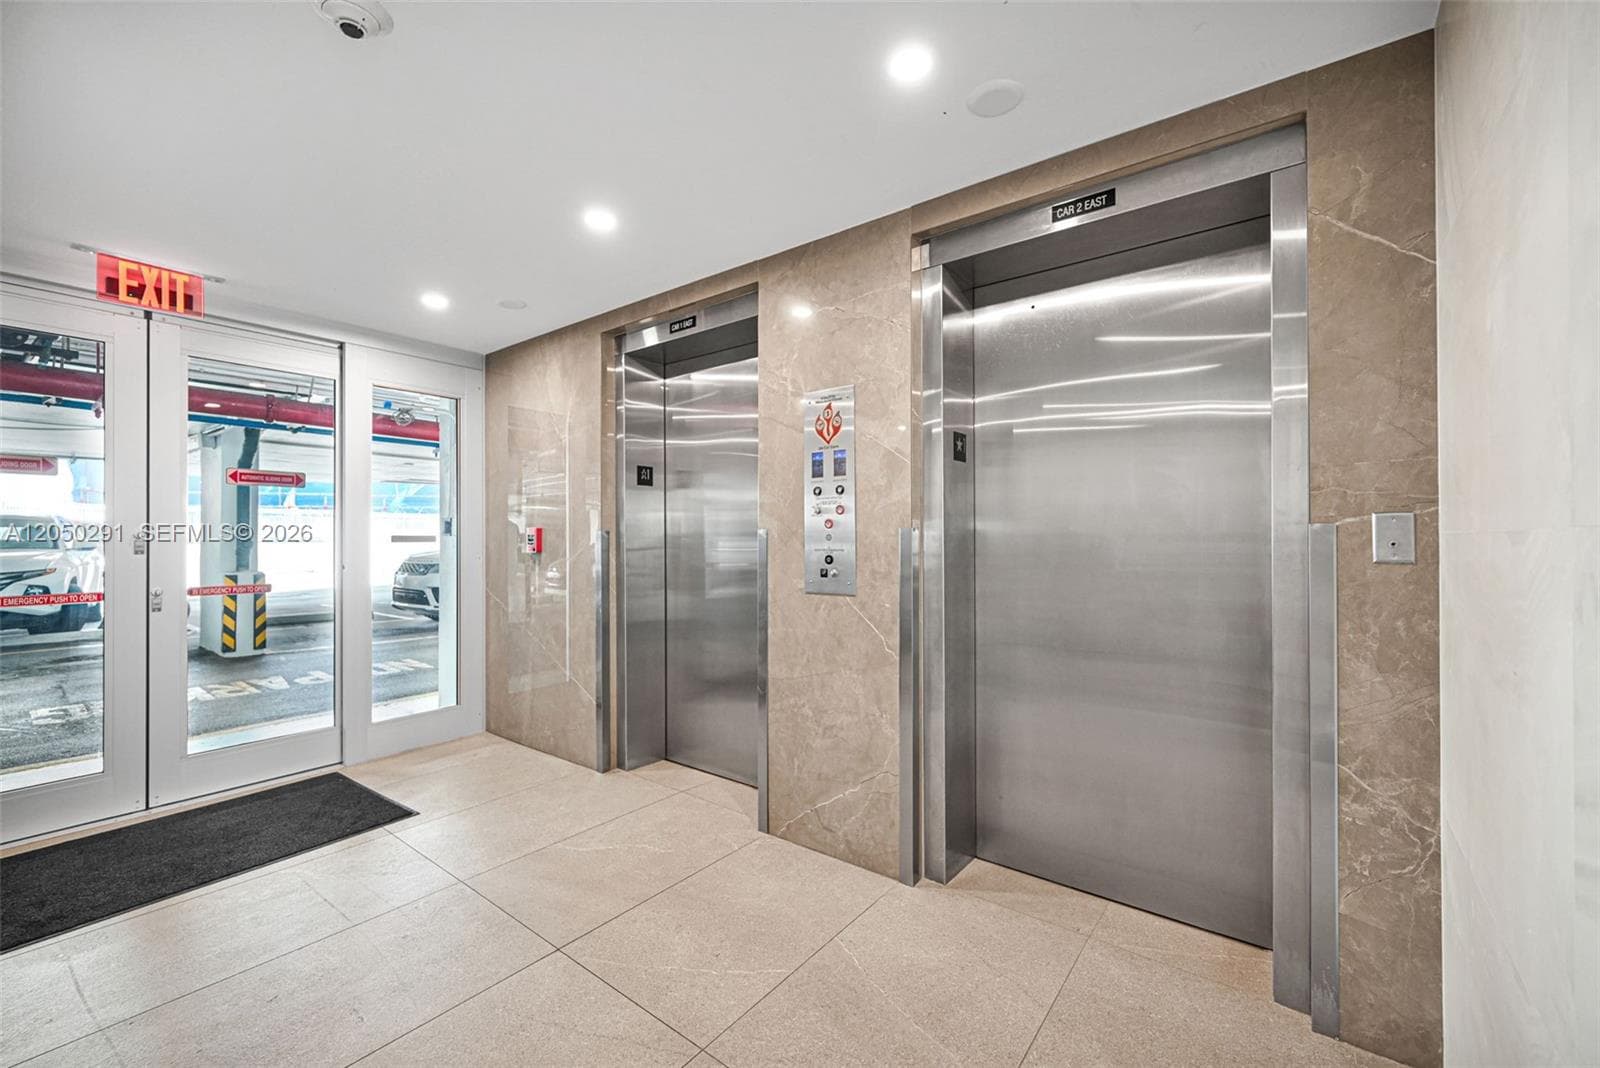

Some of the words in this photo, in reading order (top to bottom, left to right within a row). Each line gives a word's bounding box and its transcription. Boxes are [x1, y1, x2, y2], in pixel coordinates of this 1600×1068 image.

[1057, 205, 1075, 218] CAR
[1076, 202, 1083, 212] 2
[1084, 194, 1107, 210] EAST
[118, 260, 189, 313] EXIT
[3, 596, 48, 606] EMERGENCY
[50, 595, 67, 604] PUSH
[79, 594, 97, 602] OPEN
[199, 587, 231, 595] EMERGENCY
